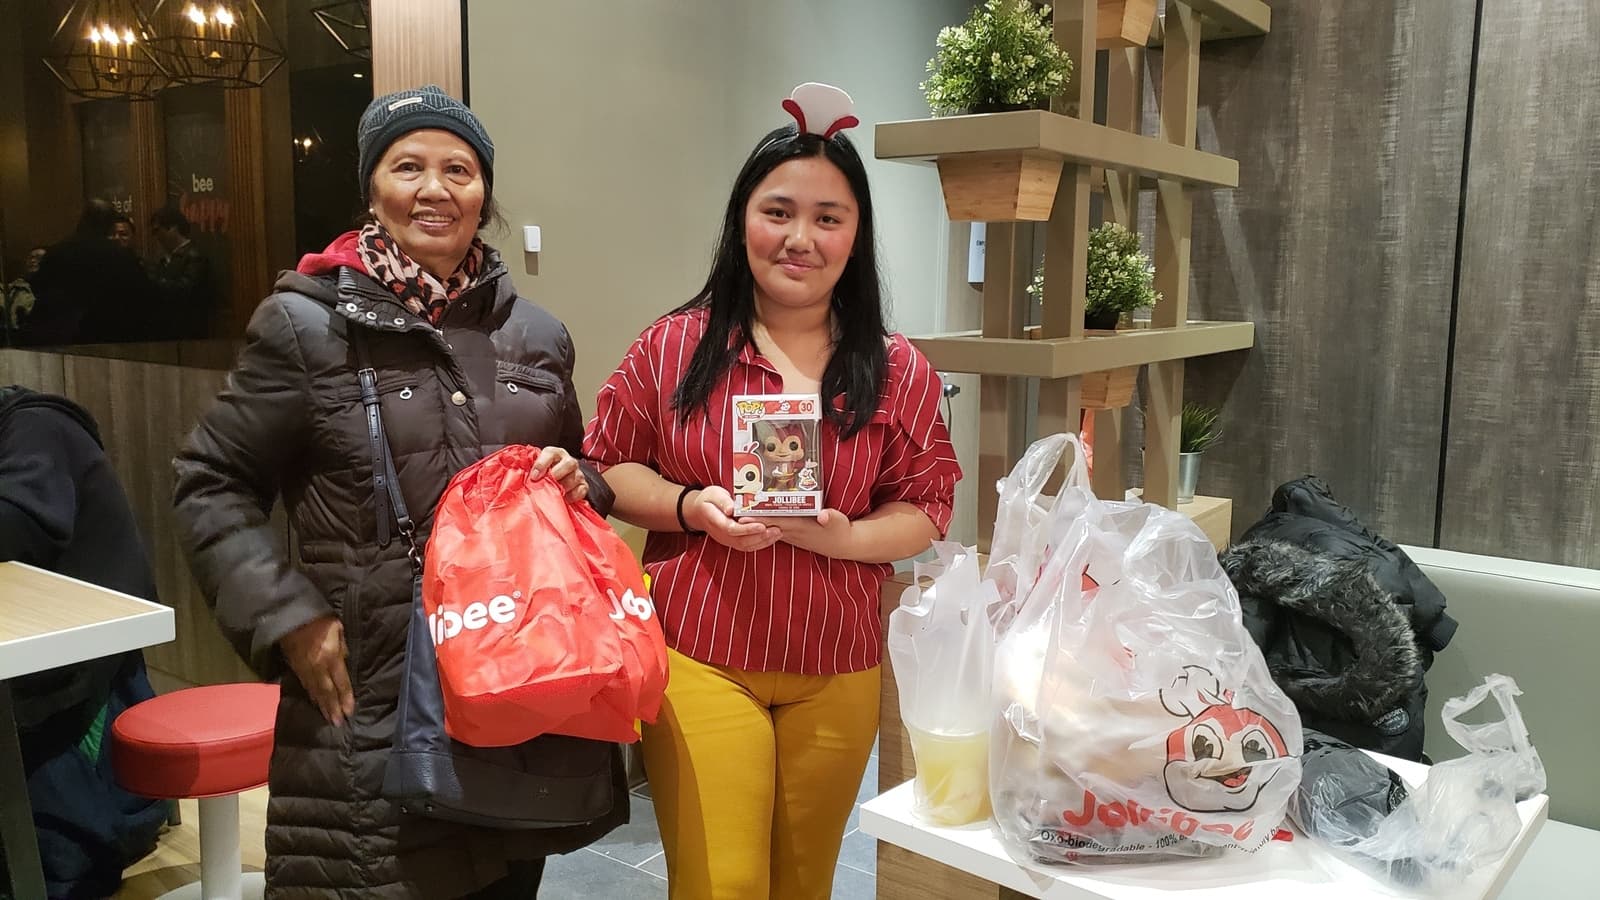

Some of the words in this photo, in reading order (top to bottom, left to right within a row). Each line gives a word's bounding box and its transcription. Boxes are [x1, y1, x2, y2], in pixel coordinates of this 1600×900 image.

[192, 173, 214, 192] bee
[800, 402, 813, 412] 30
[772, 496, 806, 504] JOLLIBEE
[1156, 833, 1178, 849] 100%
